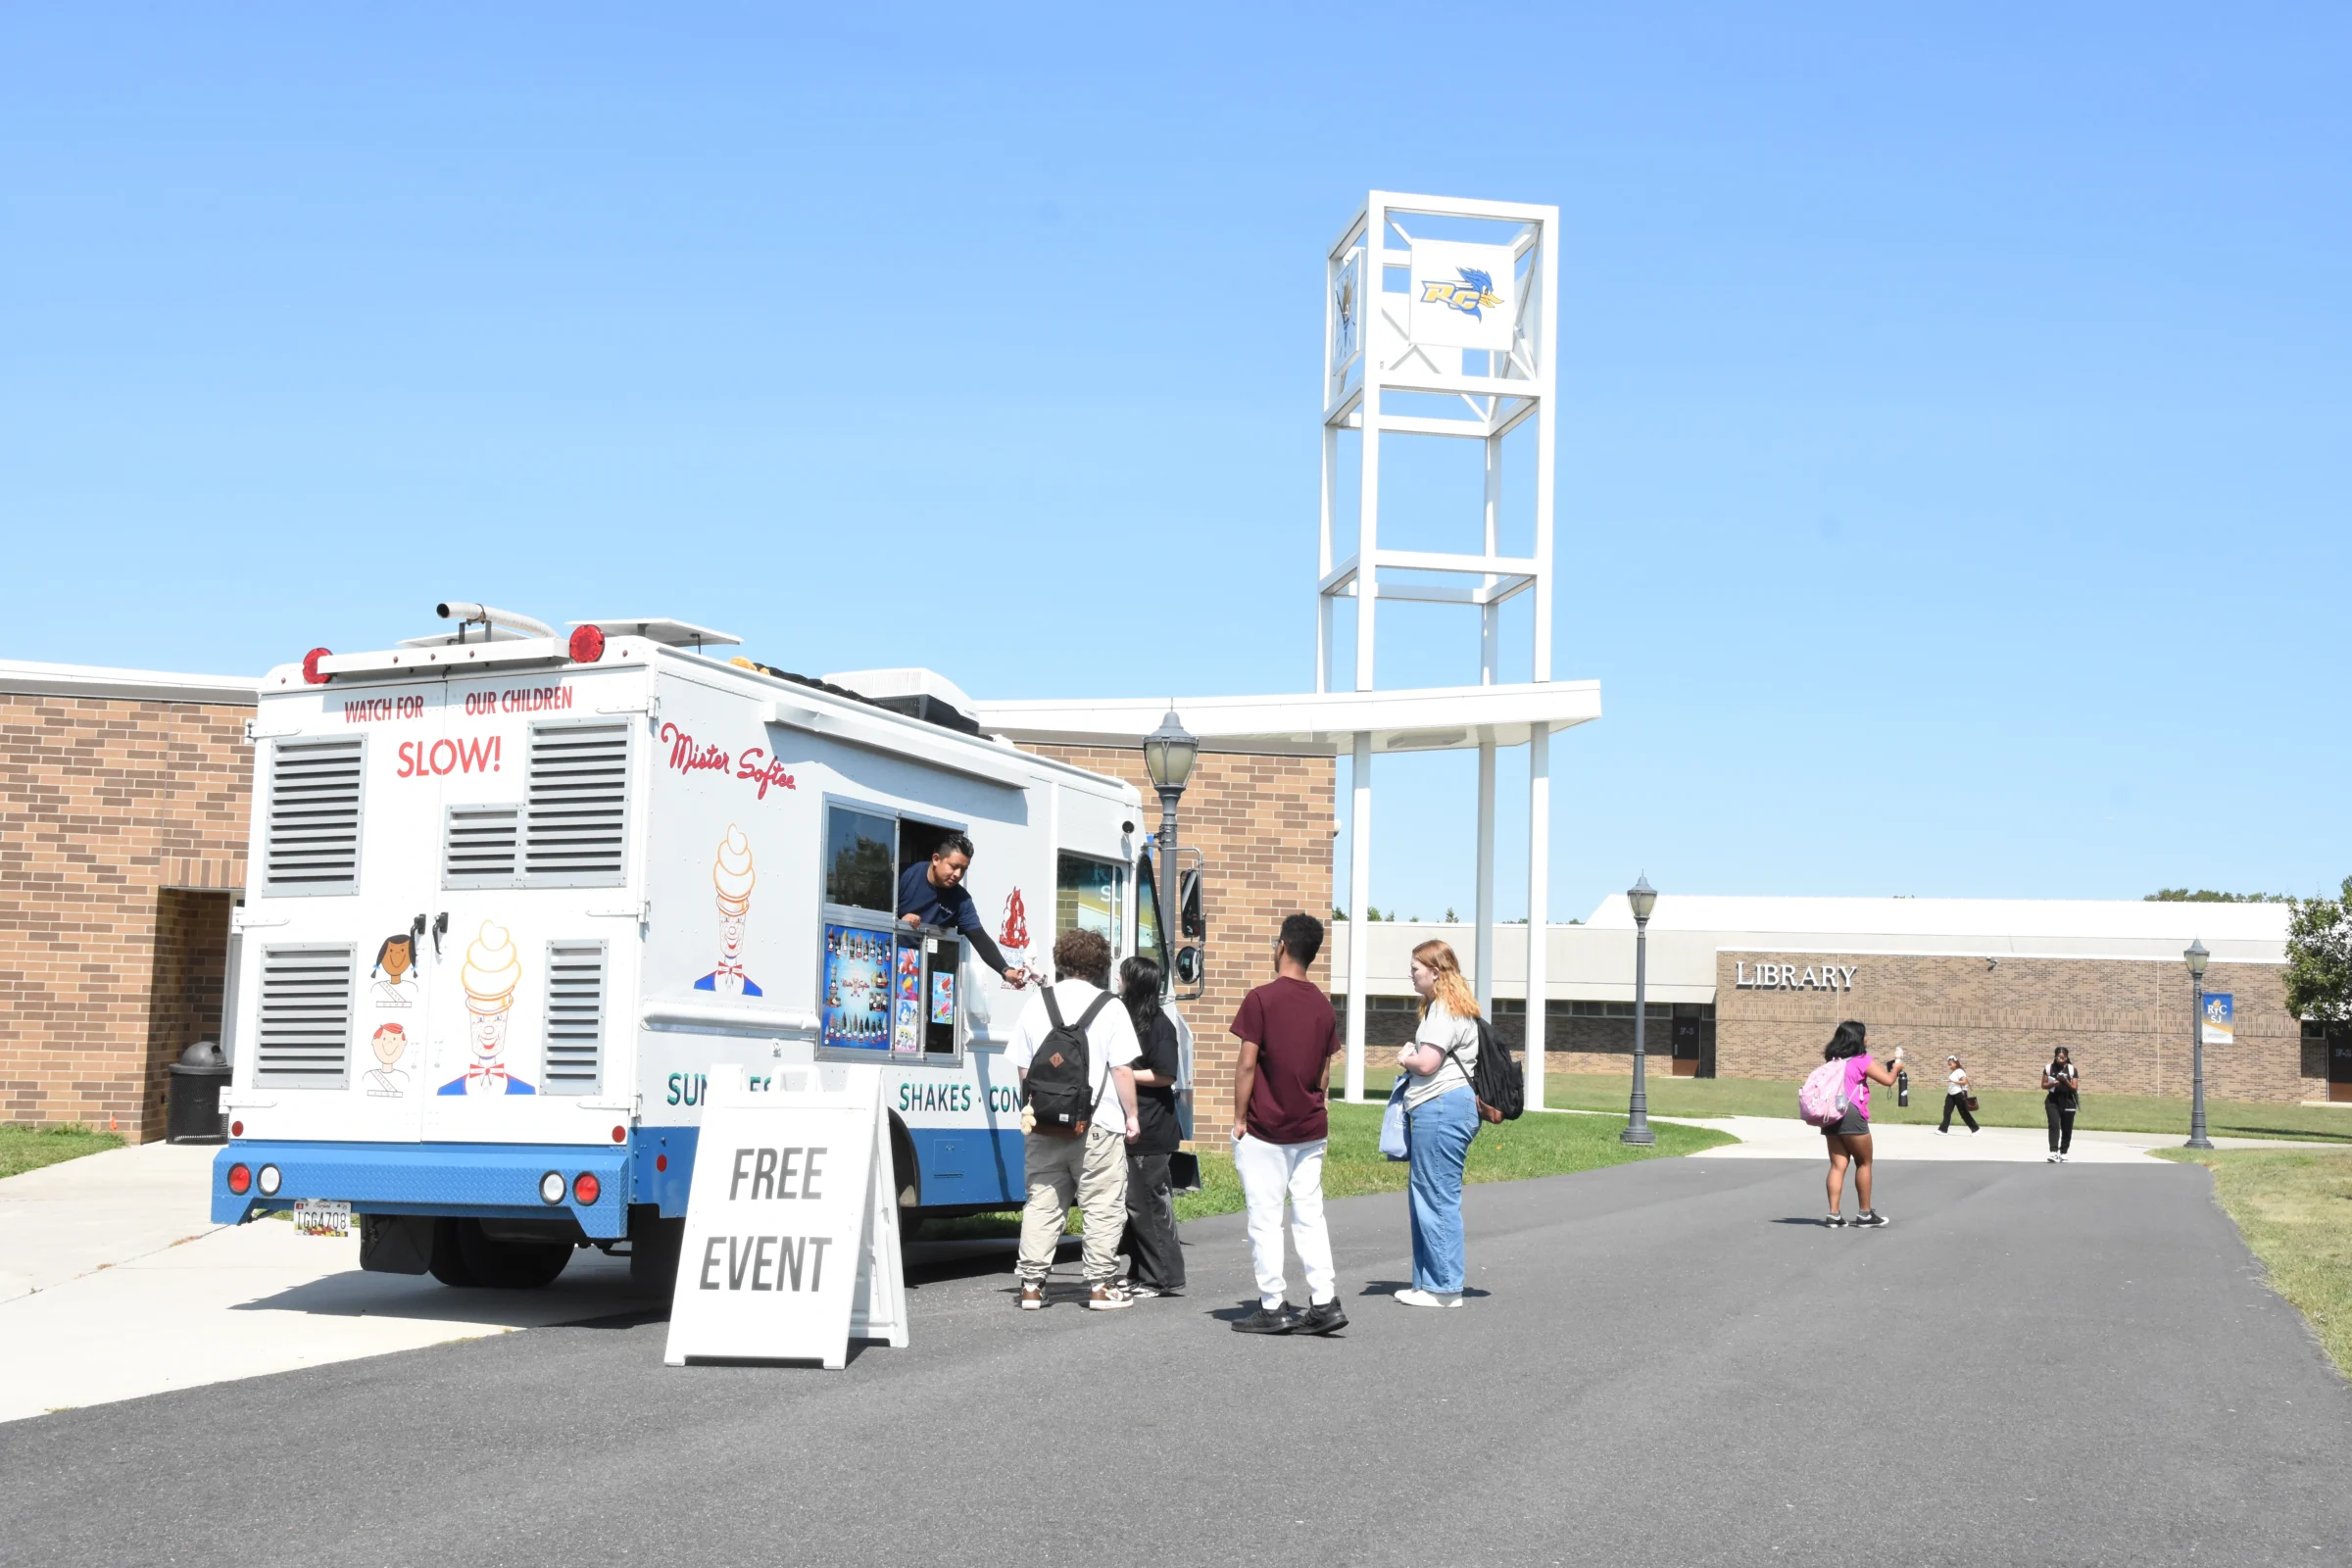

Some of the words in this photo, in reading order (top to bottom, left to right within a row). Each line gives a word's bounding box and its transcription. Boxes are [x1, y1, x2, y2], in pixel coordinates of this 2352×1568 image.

[344, 701, 392, 723] WATCH
[396, 697, 424, 718] FOR
[466, 691, 497, 715] OUR
[501, 686, 573, 713] CHILDREN
[396, 735, 502, 778] SLOW!
[660, 722, 730, 774] Mister
[736, 748, 797, 800] Softee
[1737, 961, 1857, 989] LIBRARY
[2210, 1014, 2222, 1023] SJ
[899, 1082, 971, 1111] SHAKES
[989, 1085, 1024, 1112] CON
[729, 1148, 827, 1200] FREE
[699, 1236, 833, 1293] EVENT
